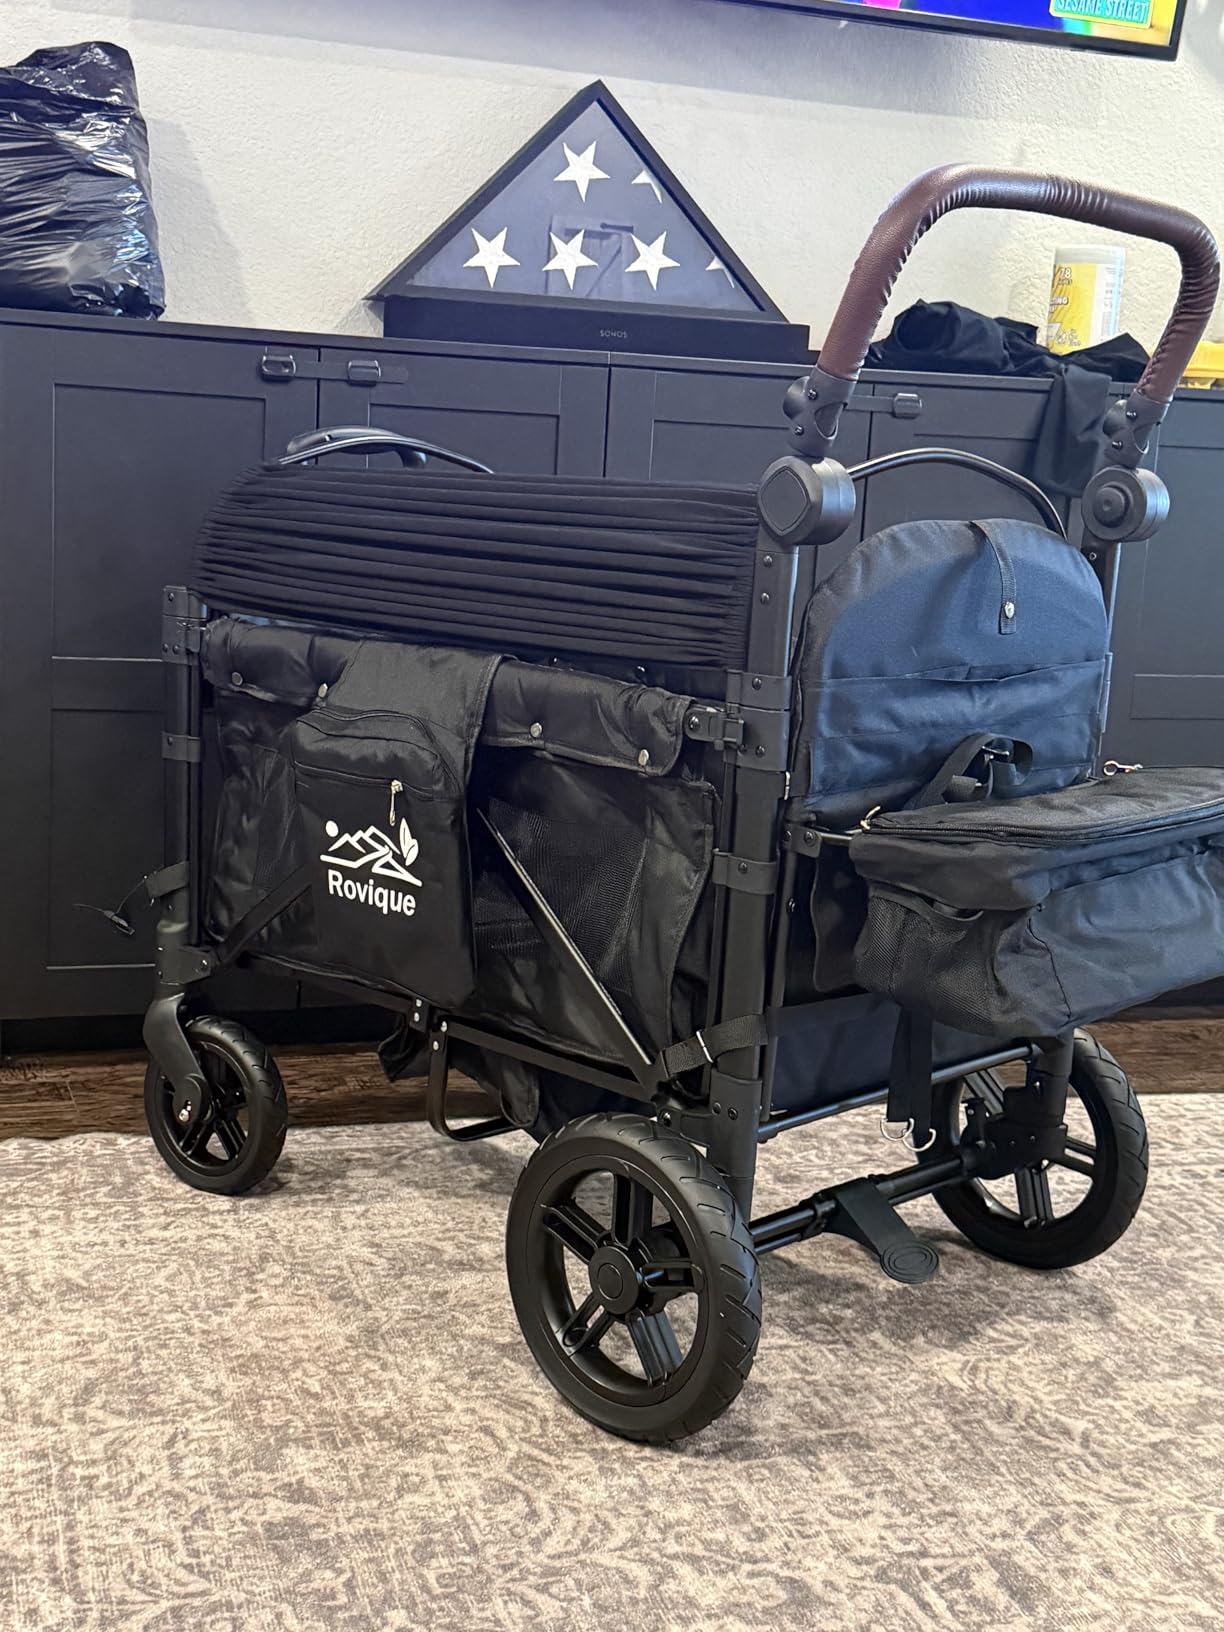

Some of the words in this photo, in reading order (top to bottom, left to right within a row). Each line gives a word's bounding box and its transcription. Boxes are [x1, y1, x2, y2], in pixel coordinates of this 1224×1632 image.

[1058, 0, 1101, 15] SESAME
[1106, 0, 1147, 22] STREET
[600, 330, 627, 338] SONOS
[328, 869, 416, 916] Rovique
